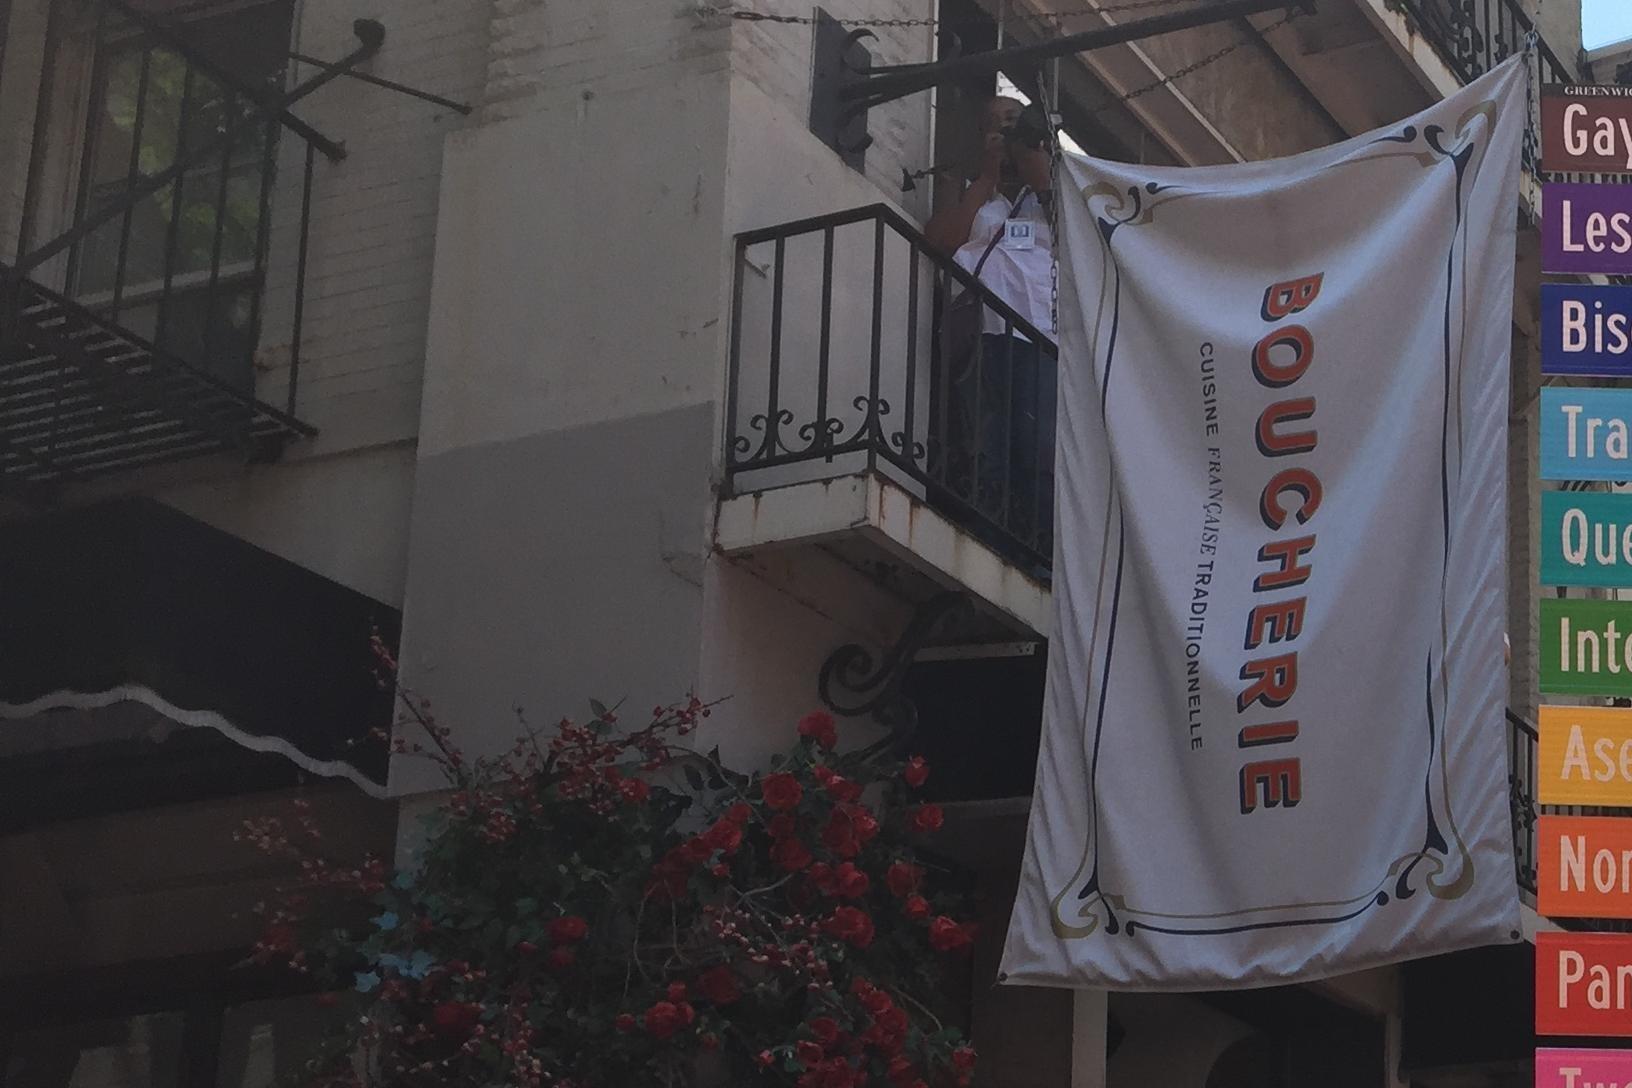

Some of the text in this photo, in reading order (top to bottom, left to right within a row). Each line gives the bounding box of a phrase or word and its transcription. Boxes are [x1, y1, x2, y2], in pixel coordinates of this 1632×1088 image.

[1185, 341, 1224, 751] CUISINE FRANÇAISE TRADITIONNELLE
[1237, 271, 1325, 816] BOUCHERIE
